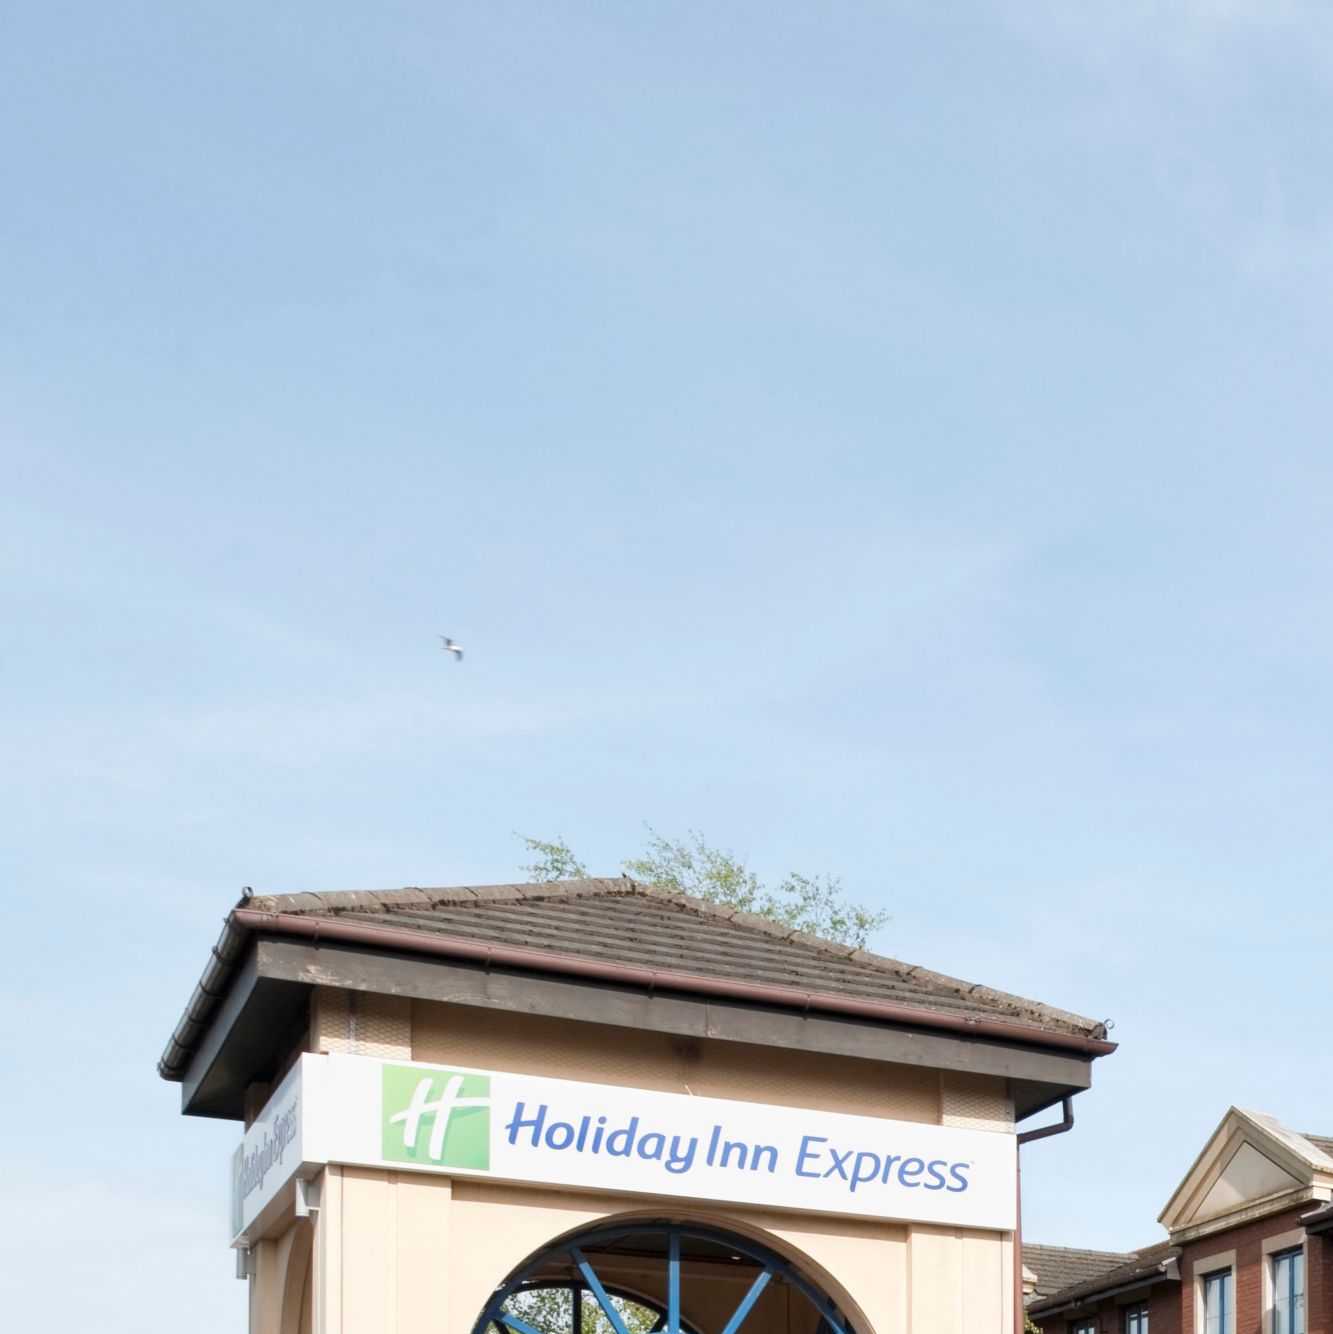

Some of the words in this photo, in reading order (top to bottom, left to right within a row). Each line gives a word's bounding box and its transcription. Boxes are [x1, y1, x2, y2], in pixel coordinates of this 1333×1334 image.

[505, 1101, 698, 1174] Holiday
[706, 1125, 778, 1173] Inn
[795, 1135, 970, 1193] Express
